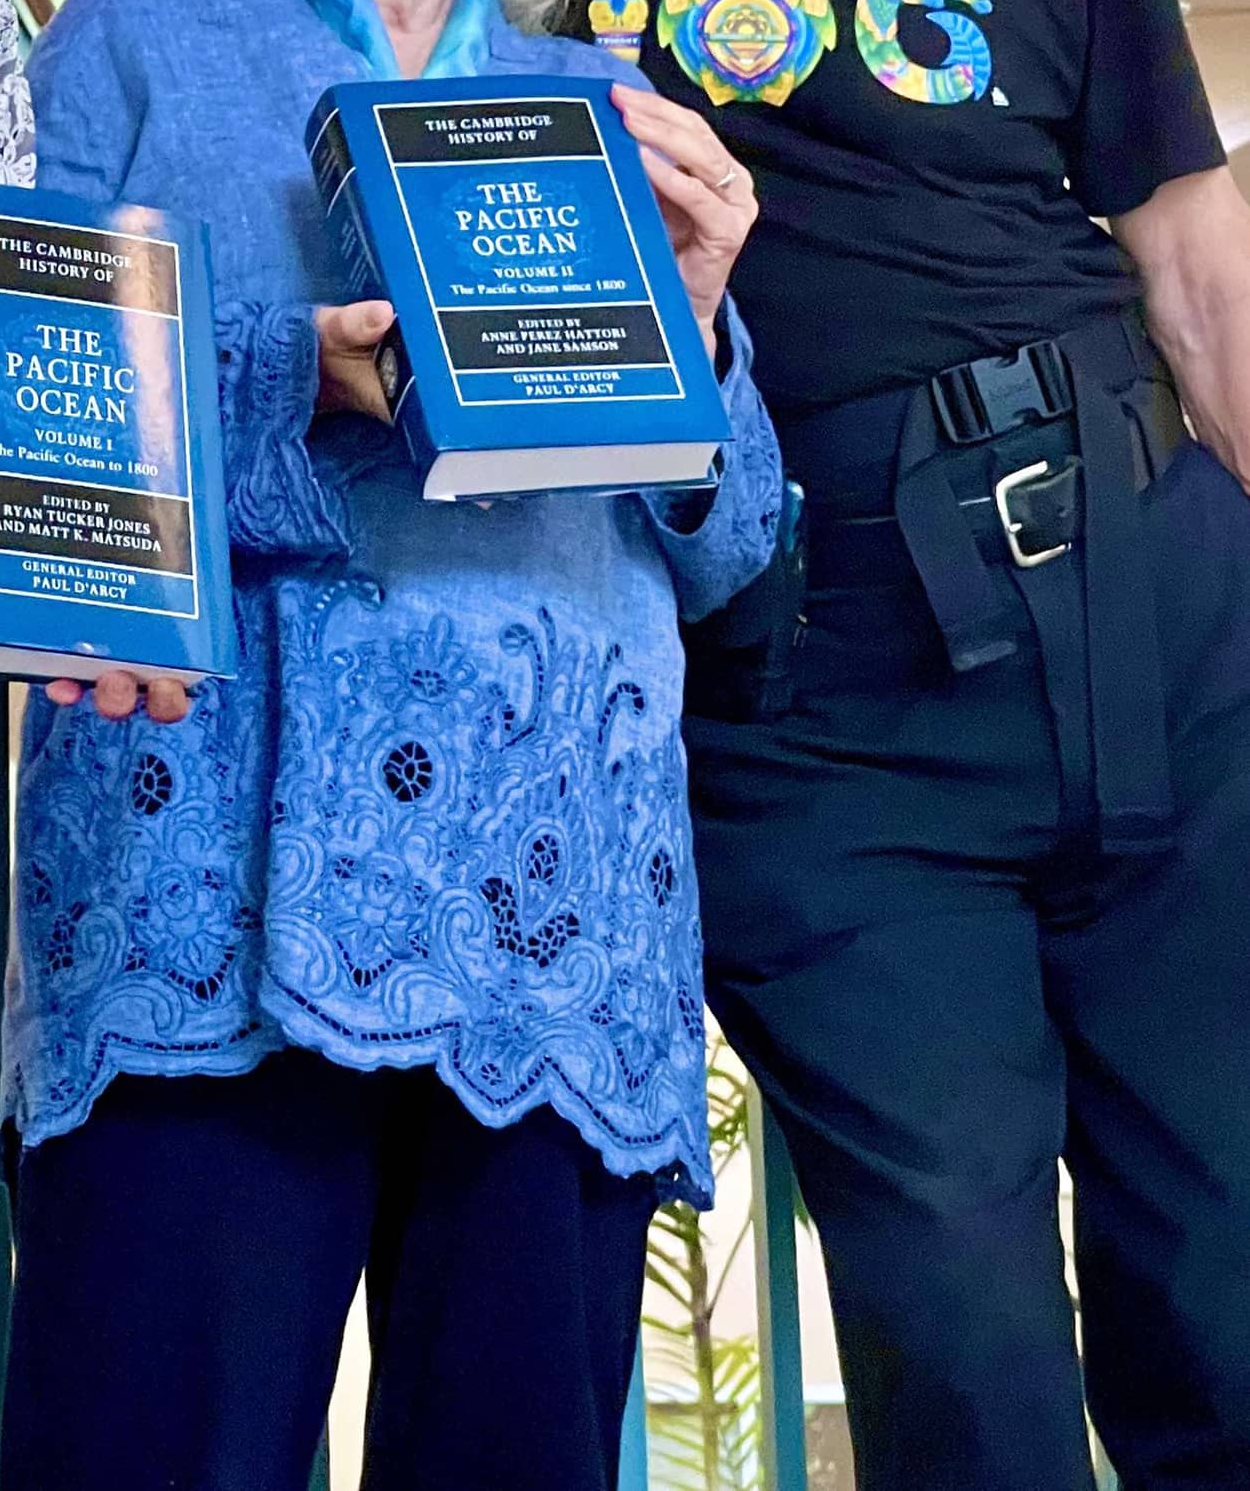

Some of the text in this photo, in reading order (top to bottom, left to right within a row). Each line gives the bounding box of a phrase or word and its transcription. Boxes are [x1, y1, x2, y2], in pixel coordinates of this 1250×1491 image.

[425, 115, 552, 131] THE CAMBRIDGE
[448, 130, 537, 145] HISTORY OF
[476, 182, 542, 204] THE
[454, 205, 579, 231] PACIFIC
[0, 238, 132, 268] THE CAMBRIDGE
[472, 232, 577, 256] OCEAN
[19, 258, 114, 282] HISTORY OF
[493, 265, 574, 279] VOLUME II
[450, 279, 626, 295] The Pacific Ocean since 1800
[481, 327, 627, 342] ANNE PEREZ HATTORI
[518, 318, 581, 329] EDITED BY
[36, 324, 102, 357] THE
[497, 341, 619, 355] AND JANE SAMSON
[6, 352, 135, 393] PACIFIC
[513, 371, 622, 383] GENERAL EDITOR
[525, 383, 615, 396] PAUL D'ARCY
[16, 385, 126, 424] OCEAN
[34, 428, 113, 451] VOLUME I
[18, 446, 61, 463] Pacific
[64, 453, 105, 470] Ocean
[109, 461, 122, 471] to
[128, 461, 158, 476] 1800
[43, 495, 111, 513] EDITED BY
[3, 504, 150, 535] RYAN TUCKER JONES
[29, 523, 69, 539] MATT
[74, 529, 89, 542] K.
[91, 532, 162, 552] MATSUDA
[22, 560, 136, 585] GENERAL EDITOR
[33, 576, 127, 599] PAUL D'ARCY
